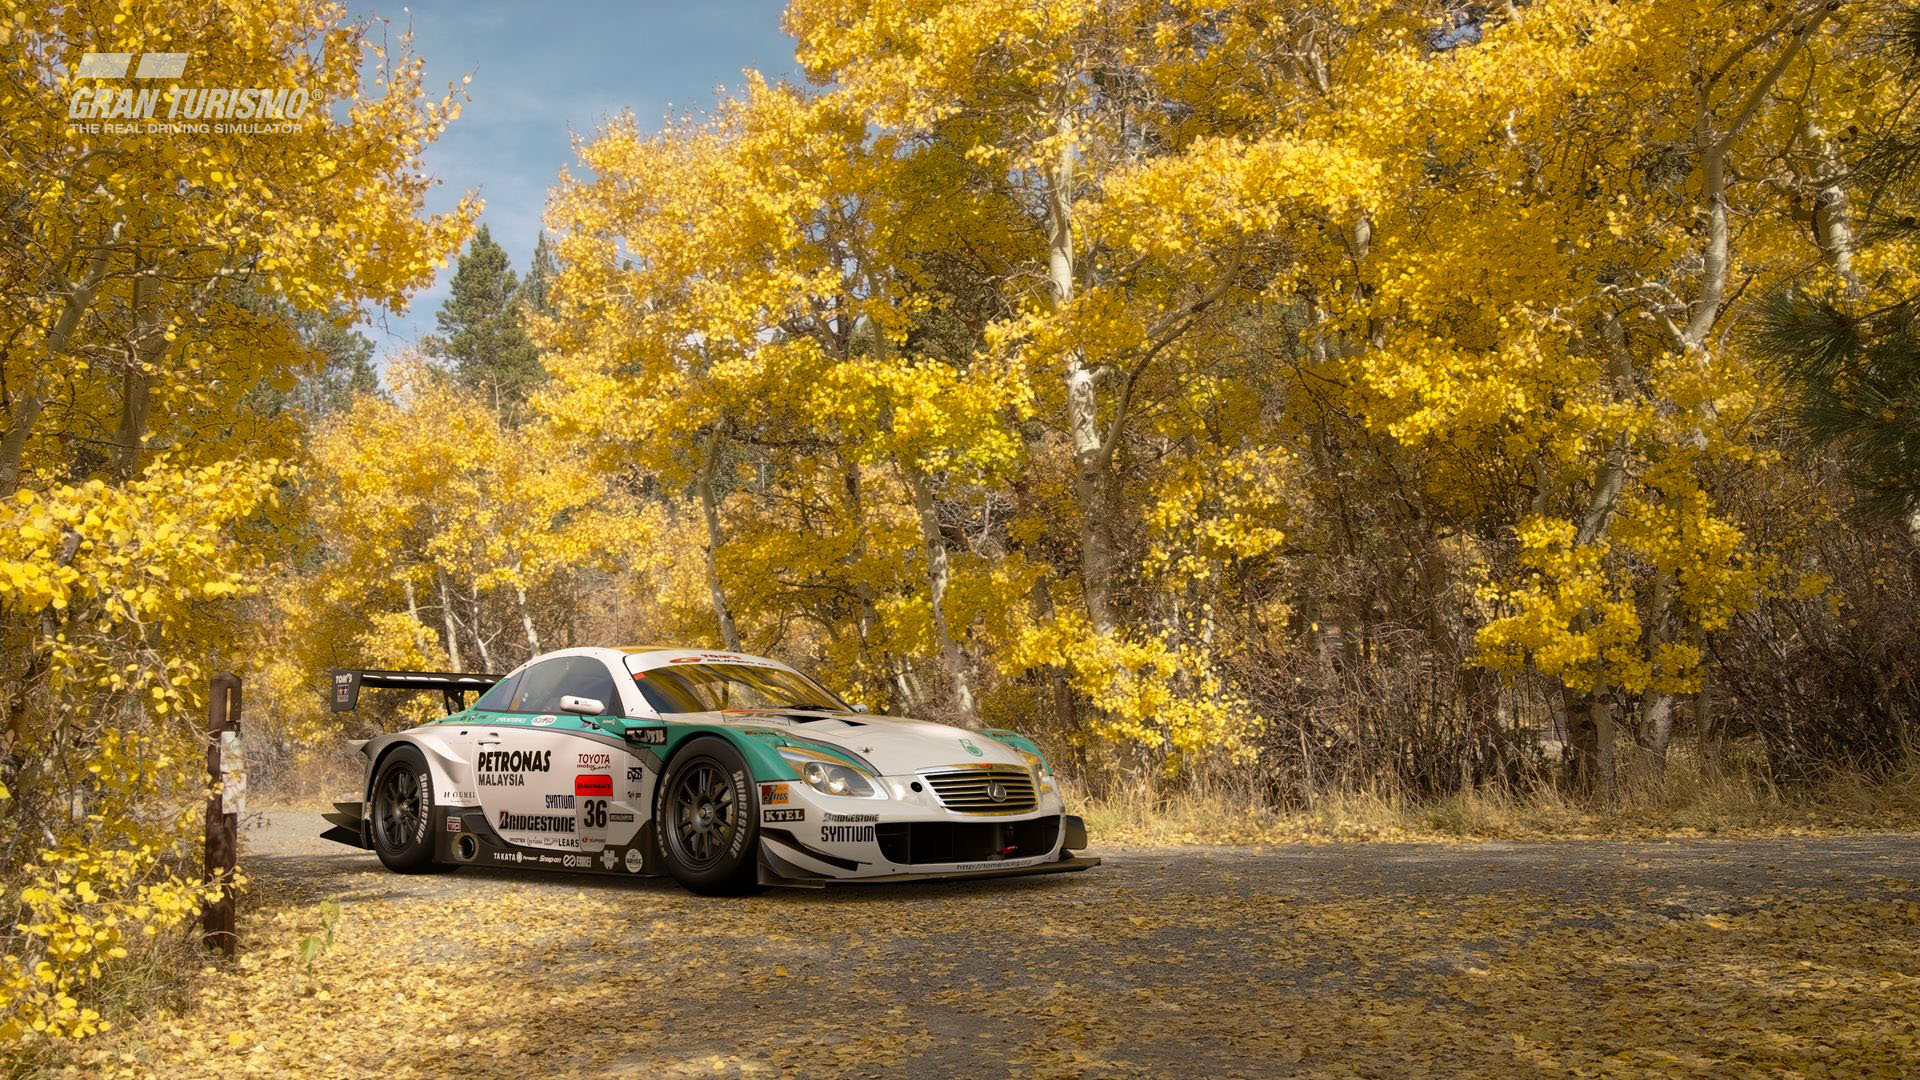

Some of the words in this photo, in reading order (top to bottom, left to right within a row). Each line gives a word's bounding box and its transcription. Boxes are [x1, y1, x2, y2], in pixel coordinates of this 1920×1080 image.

[335, 673, 353, 684] TOM'S
[478, 750, 551, 772] PETRONAS
[578, 754, 610, 764] TOYOTA
[478, 774, 525, 786] MALAYSIA
[416, 773, 429, 844] BRIDGESTONE
[545, 795, 575, 809] SYNTIUM
[583, 799, 607, 828] 36
[730, 769, 748, 859] BRIDGESTONE
[765, 811, 803, 820] KTEL
[822, 813, 879, 822] BRIDGESTONE
[498, 811, 575, 832] BRIDGESTONE
[821, 826, 874, 842] SYNTIUM
[558, 839, 579, 847] LEARS
[493, 853, 516, 861] TAKATA
